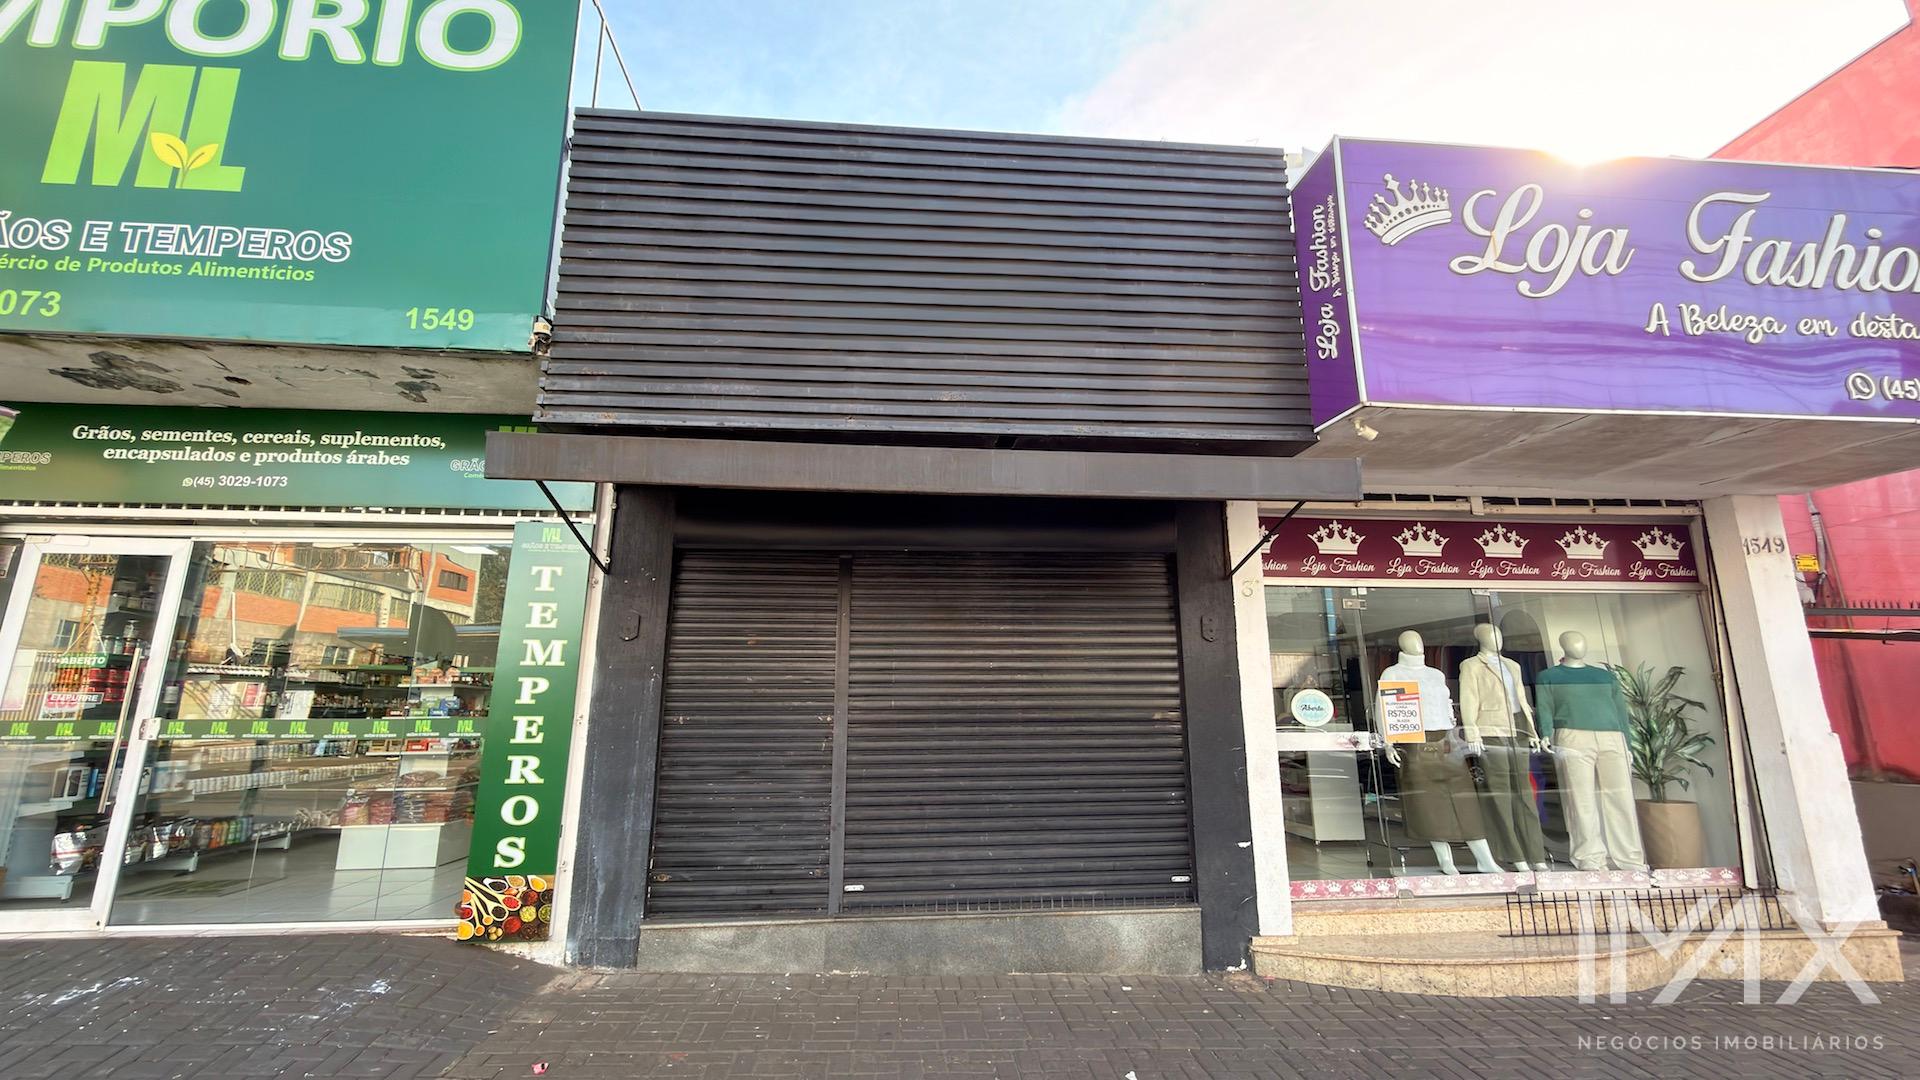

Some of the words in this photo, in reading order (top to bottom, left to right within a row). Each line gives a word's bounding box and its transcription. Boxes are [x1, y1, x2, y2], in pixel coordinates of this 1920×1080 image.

[41, 60, 246, 192] ML
[79, 220, 113, 252] E
[120, 222, 352, 262] TEMPEROS
[1309, 204, 1330, 292] Fashion
[1449, 183, 1635, 298] Loja
[1679, 191, 1920, 293] Fashio
[54, 256, 81, 271] de
[87, 258, 182, 275] Produtos
[188, 261, 315, 281] Alimentícios
[0, 289, 61, 317] 073
[405, 307, 474, 331] 1549
[1315, 303, 1340, 359] Loja
[1645, 303, 1669, 336] A
[1678, 304, 1787, 344] Beleza
[1797, 316, 1838, 337] em
[72, 425, 136, 442] Grãos,
[141, 429, 237, 445] sementes,
[242, 430, 316, 447] cereais,
[320, 431, 446, 449] suplementos,
[103, 446, 235, 463] encapsulados
[239, 451, 251, 462] e
[253, 449, 342, 466] produtos
[346, 450, 410, 465] árabes
[193, 476, 215, 488] (45)
[218, 476, 288, 488] 3029-1073
[1301, 555, 1327, 576] Loja
[1329, 557, 1375, 574] Fashion
[1386, 557, 1412, 578] Loja
[1415, 559, 1459, 575] Fashion
[1468, 559, 1495, 579] Loja
[1497, 561, 1540, 576] Fashion
[1551, 561, 1576, 580] Loja
[1578, 562, 1621, 578] Fashion
[1628, 561, 1653, 580] Loja
[1655, 562, 1697, 578] Fashion
[61, 656, 105, 665] ABERTO
[494, 565, 567, 868] TEMPEROS
